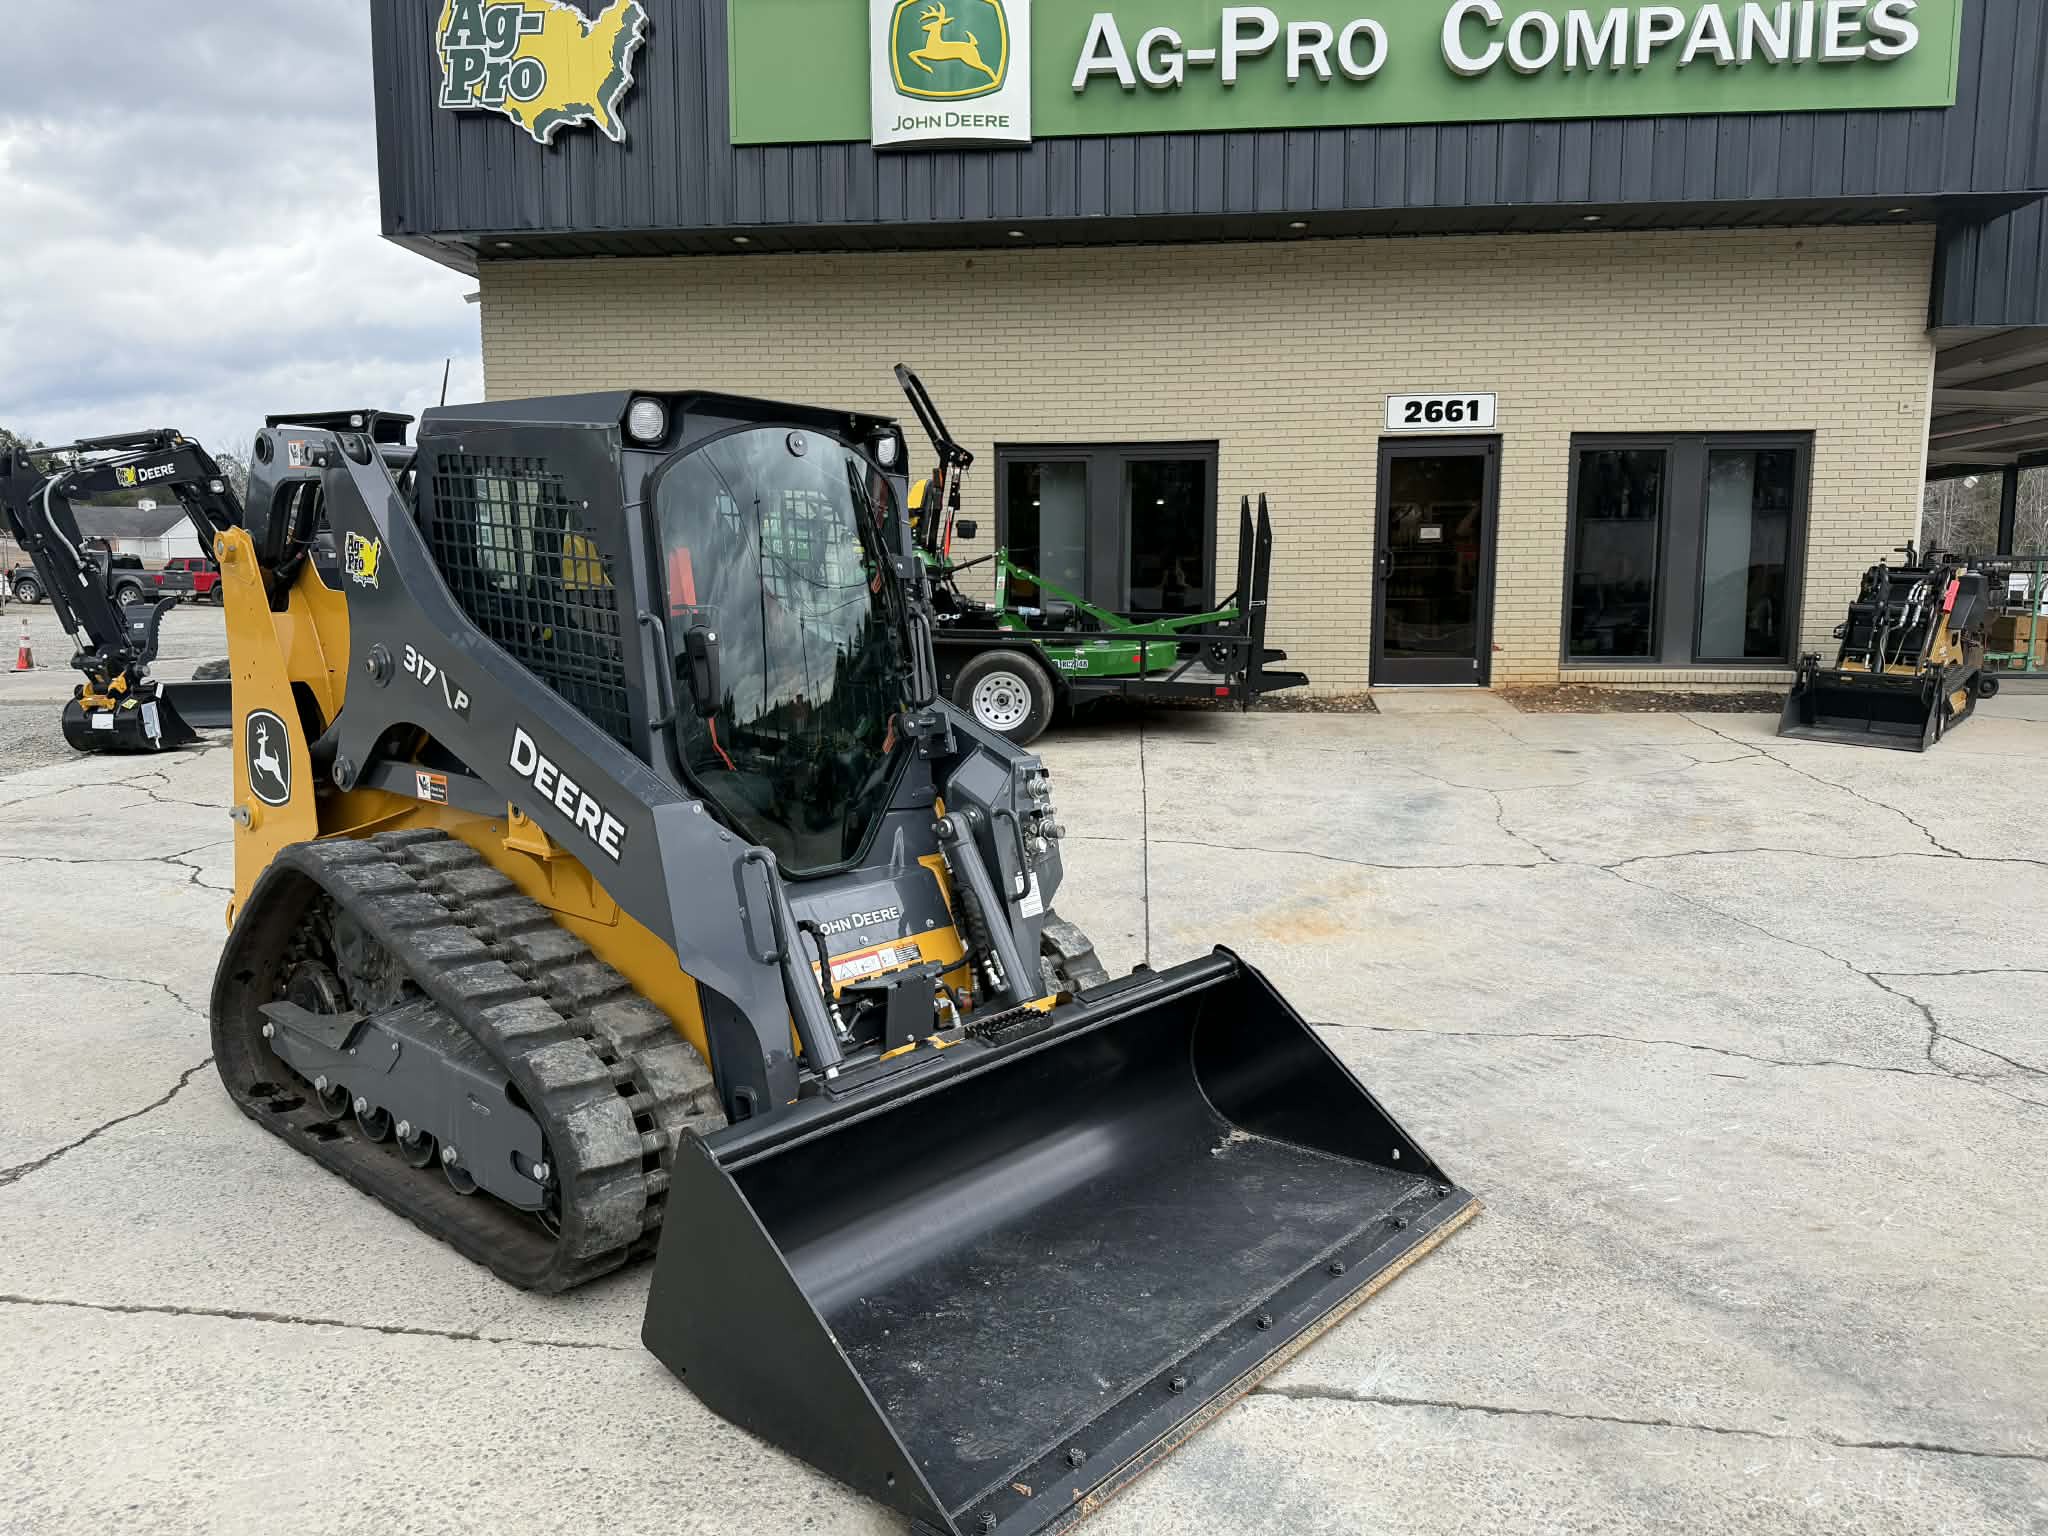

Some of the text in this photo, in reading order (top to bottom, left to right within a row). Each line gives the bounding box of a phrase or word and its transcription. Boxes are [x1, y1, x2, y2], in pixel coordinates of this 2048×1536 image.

[443, 48, 546, 103] Pro
[891, 112, 1010, 131] JOHN DEERE
[1404, 400, 1479, 423] 2661
[138, 463, 176, 482] DEERE
[510, 728, 625, 860] DEERE
[851, 906, 900, 928] DEERE
